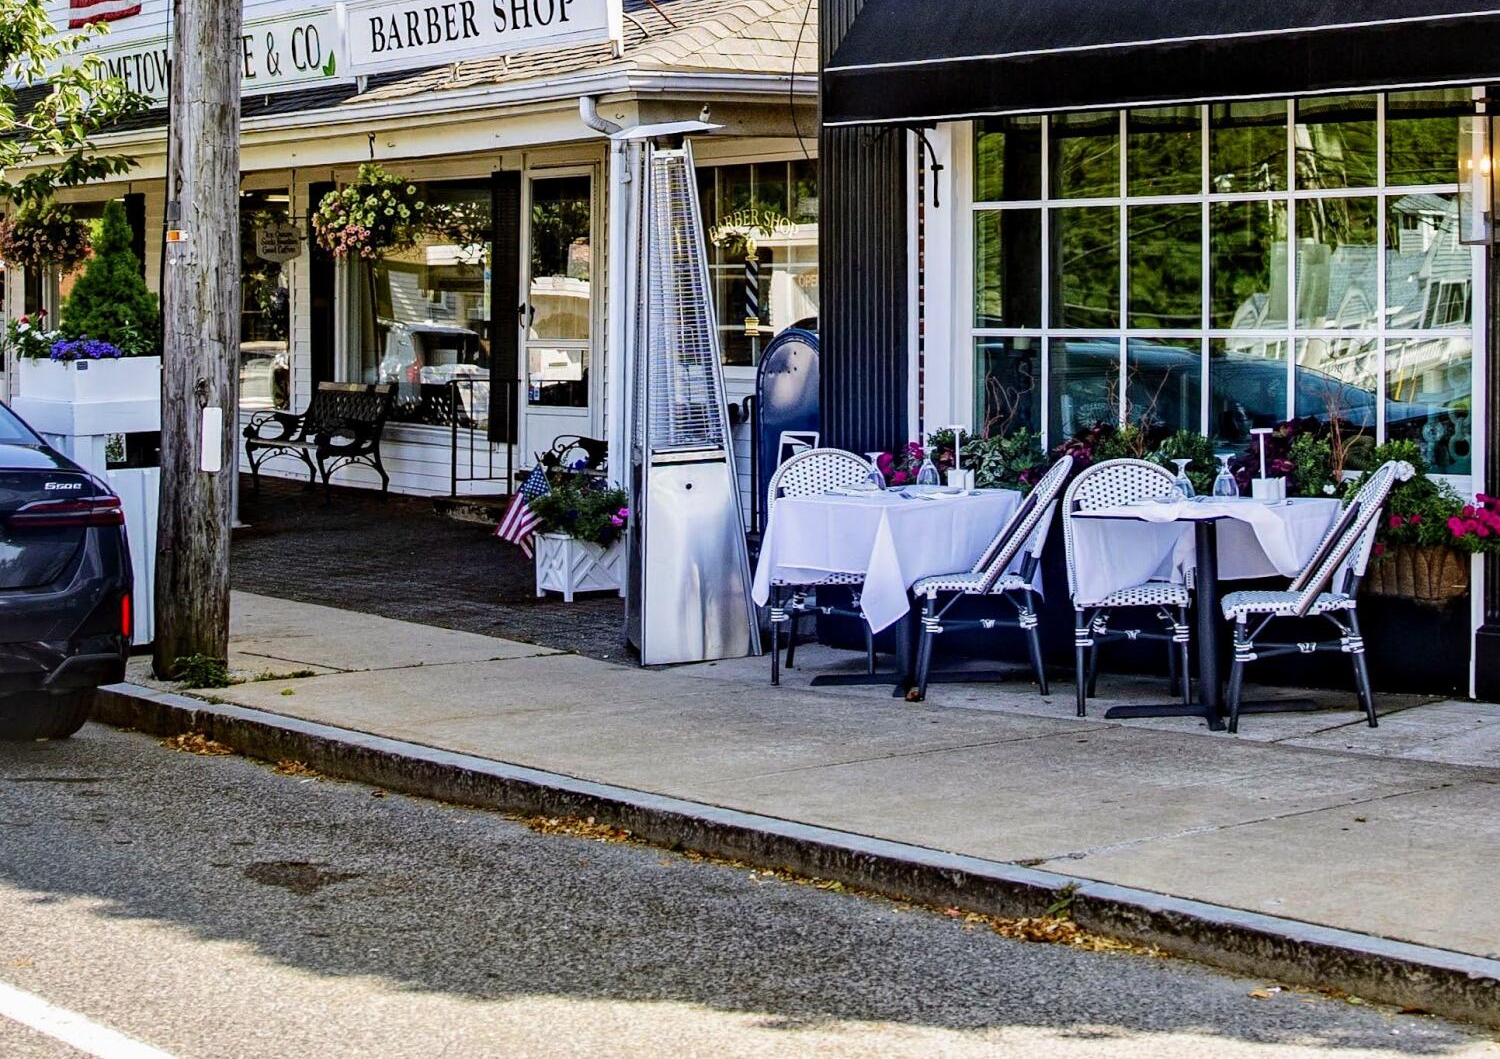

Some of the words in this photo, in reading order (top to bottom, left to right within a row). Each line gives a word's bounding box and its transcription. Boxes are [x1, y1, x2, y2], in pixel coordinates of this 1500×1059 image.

[266, 31, 282, 76] &
[291, 24, 321, 70] CO
[369, 0, 480, 52] BARBER
[708, 207, 760, 243] BARBER
[763, 210, 799, 238] SHOP
